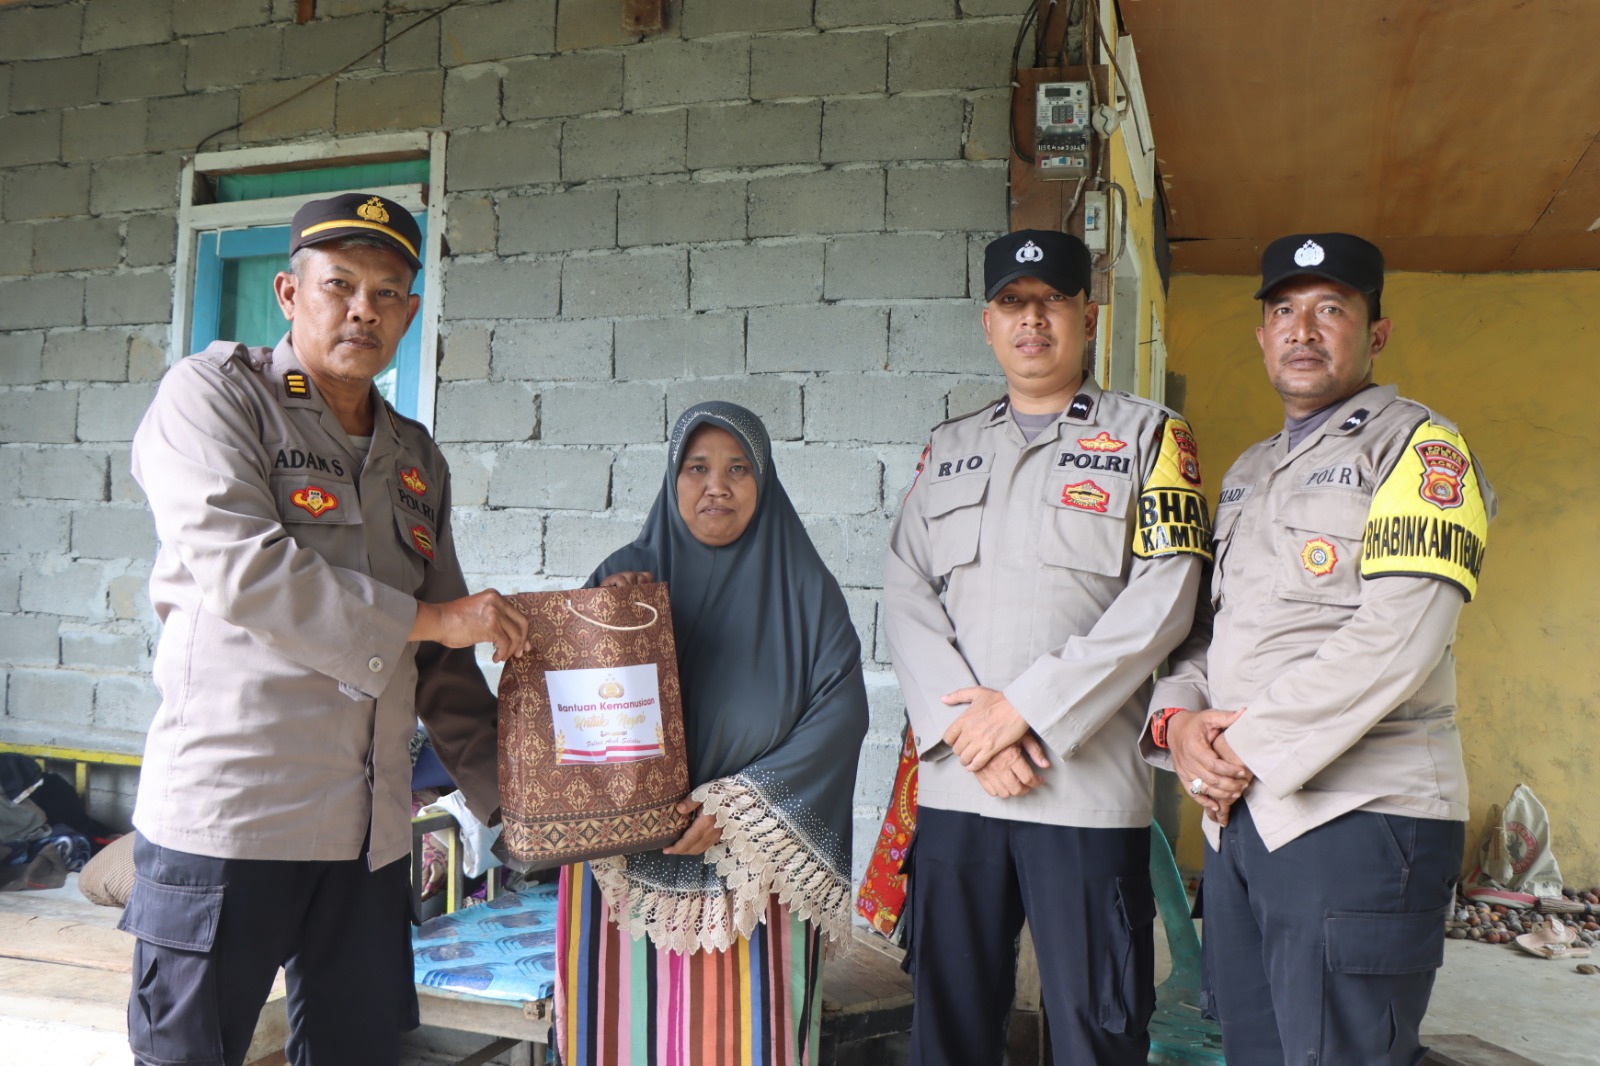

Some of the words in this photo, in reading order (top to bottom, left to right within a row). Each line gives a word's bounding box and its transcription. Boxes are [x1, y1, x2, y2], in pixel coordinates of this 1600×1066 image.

[938, 455, 983, 477] RIO
[1058, 453, 1130, 474] POLRI
[398, 488, 434, 523] POLRI
[557, 703, 597, 713] Bantuan
[600, 697, 655, 711] Kemanusiaan
